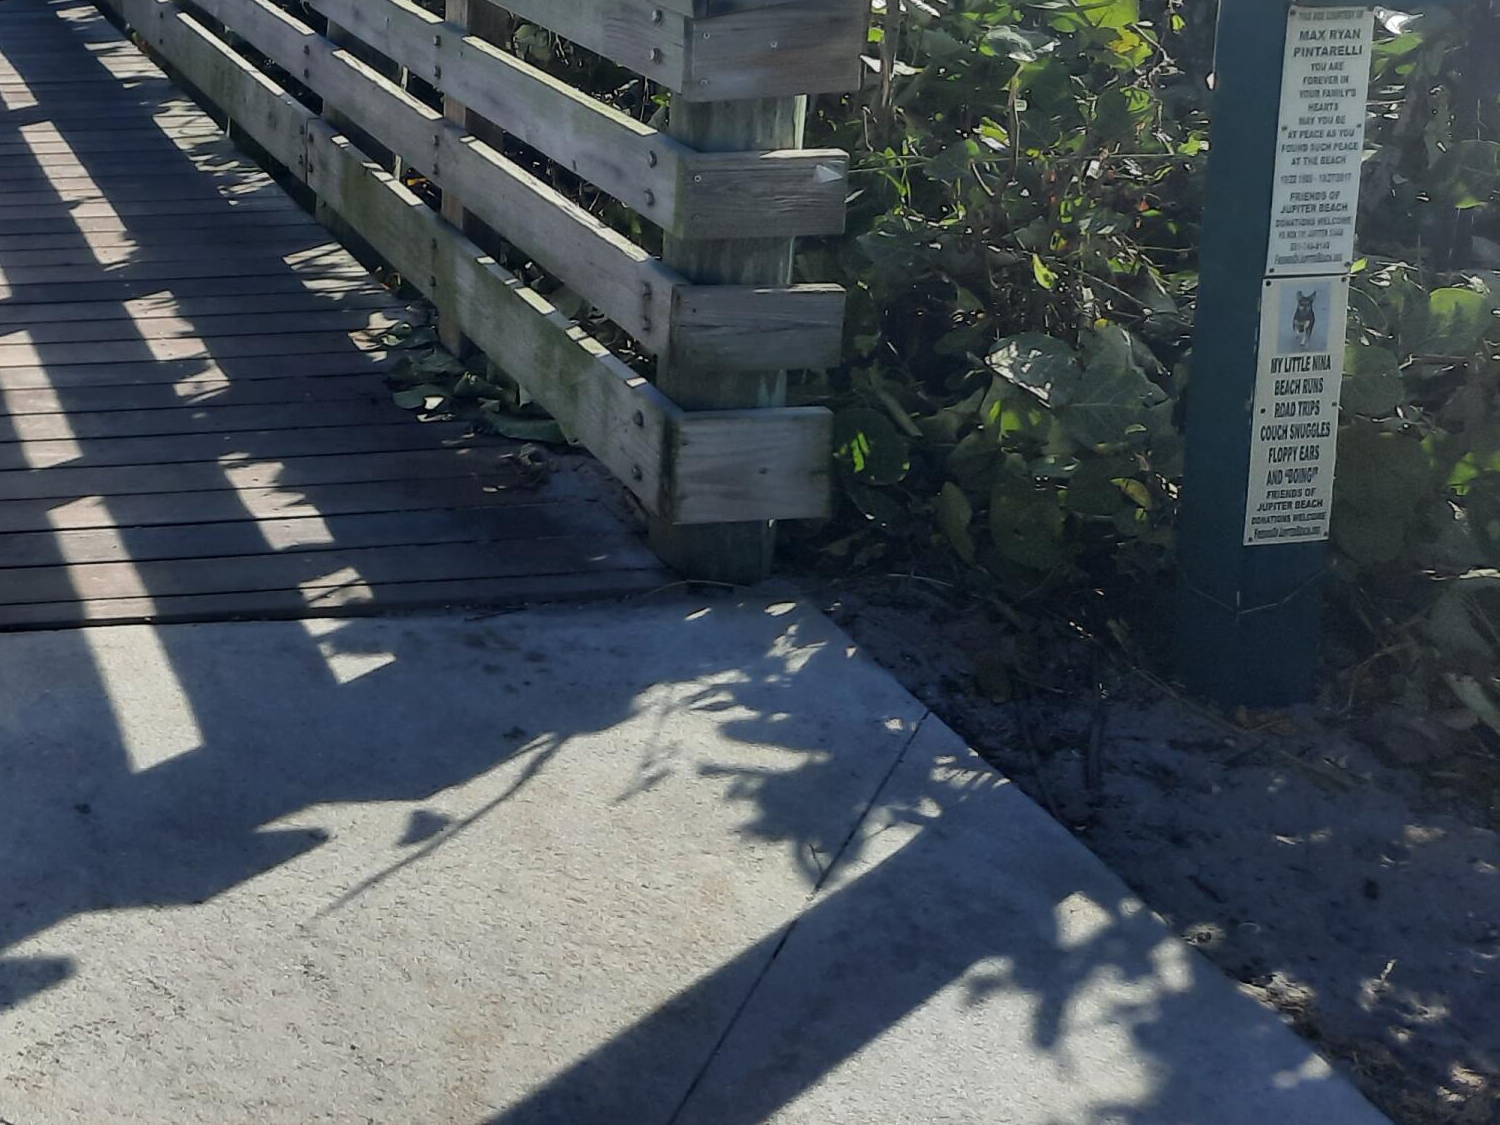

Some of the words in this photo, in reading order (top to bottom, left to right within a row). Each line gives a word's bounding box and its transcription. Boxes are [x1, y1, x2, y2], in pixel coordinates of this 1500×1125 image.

[1300, 29, 1326, 41] MAX
[1329, 28, 1361, 40] RYAN
[1293, 45, 1363, 57] PINTARELLI
[1311, 63, 1327, 72] YOU
[1328, 61, 1345, 71] ARE
[1303, 75, 1339, 85] FOREVER
[1308, 103, 1339, 112] HEARTS
[1288, 131, 1298, 139] AT
[1300, 130, 1324, 139] PEACE
[1292, 157, 1301, 165] AT
[1320, 156, 1347, 165] BEACH
[1290, 191, 1327, 202] FRIENDS
[1329, 191, 1341, 200] OF
[1280, 204, 1317, 214] JUPITER
[1318, 203, 1348, 213] BEACH
[1270, 357, 1283, 374] MY
[1284, 356, 1311, 373] LITTLE
[1312, 355, 1331, 371] NINA
[1274, 379, 1301, 396] BEACH
[1302, 377, 1324, 394] RUNS
[1274, 402, 1296, 418] ROAD
[1298, 400, 1320, 416] TRIPS
[1260, 425, 1288, 441] COUCH
[1290, 422, 1331, 439] SNUGGLES
[1268, 446, 1298, 464] FLOPPY
[1300, 445, 1320, 461] EARS
[1266, 470, 1283, 486] AND
[1266, 489, 1302, 499] FRIENDS
[1304, 488, 1317, 497] OF
[1257, 502, 1293, 512] JUPITER
[1294, 499, 1324, 509] BEACH
